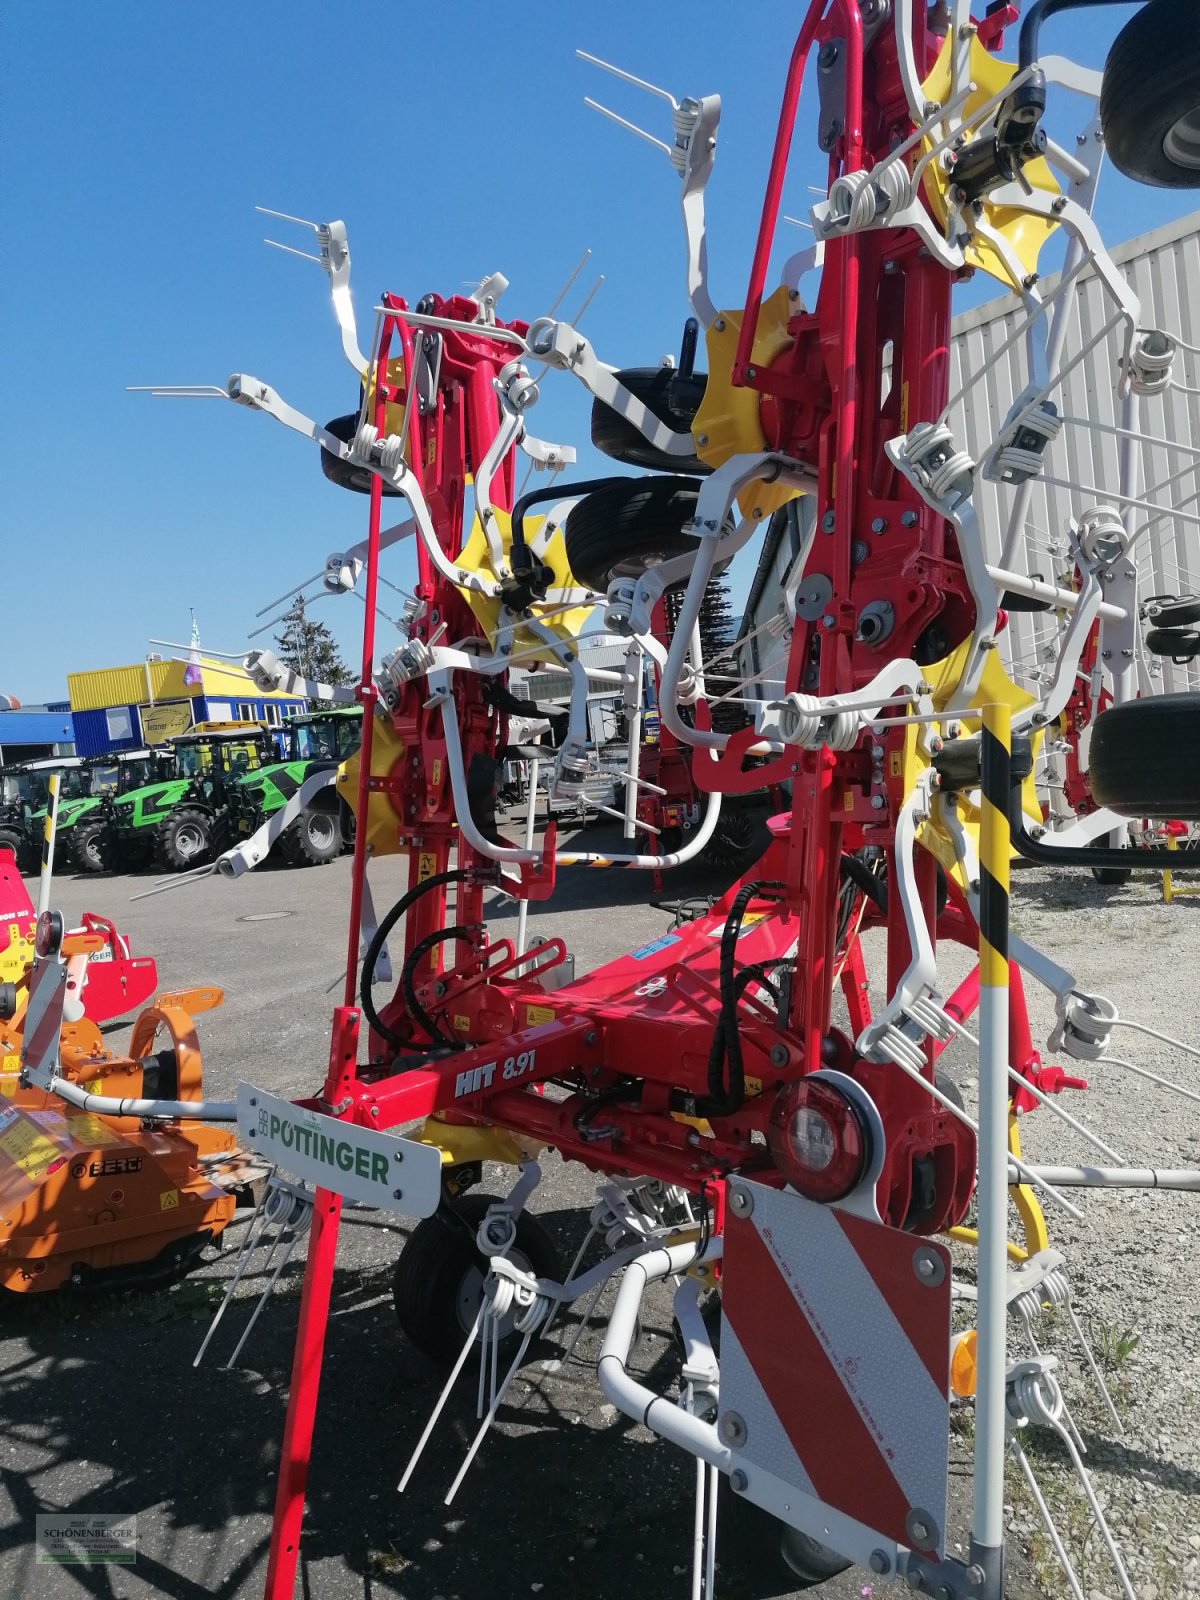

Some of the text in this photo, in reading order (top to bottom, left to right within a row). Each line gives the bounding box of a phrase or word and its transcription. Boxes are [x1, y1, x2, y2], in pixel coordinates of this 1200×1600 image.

[454, 1049, 536, 1099] HIT 8.91
[269, 1113, 390, 1186] PÖTTINGER
